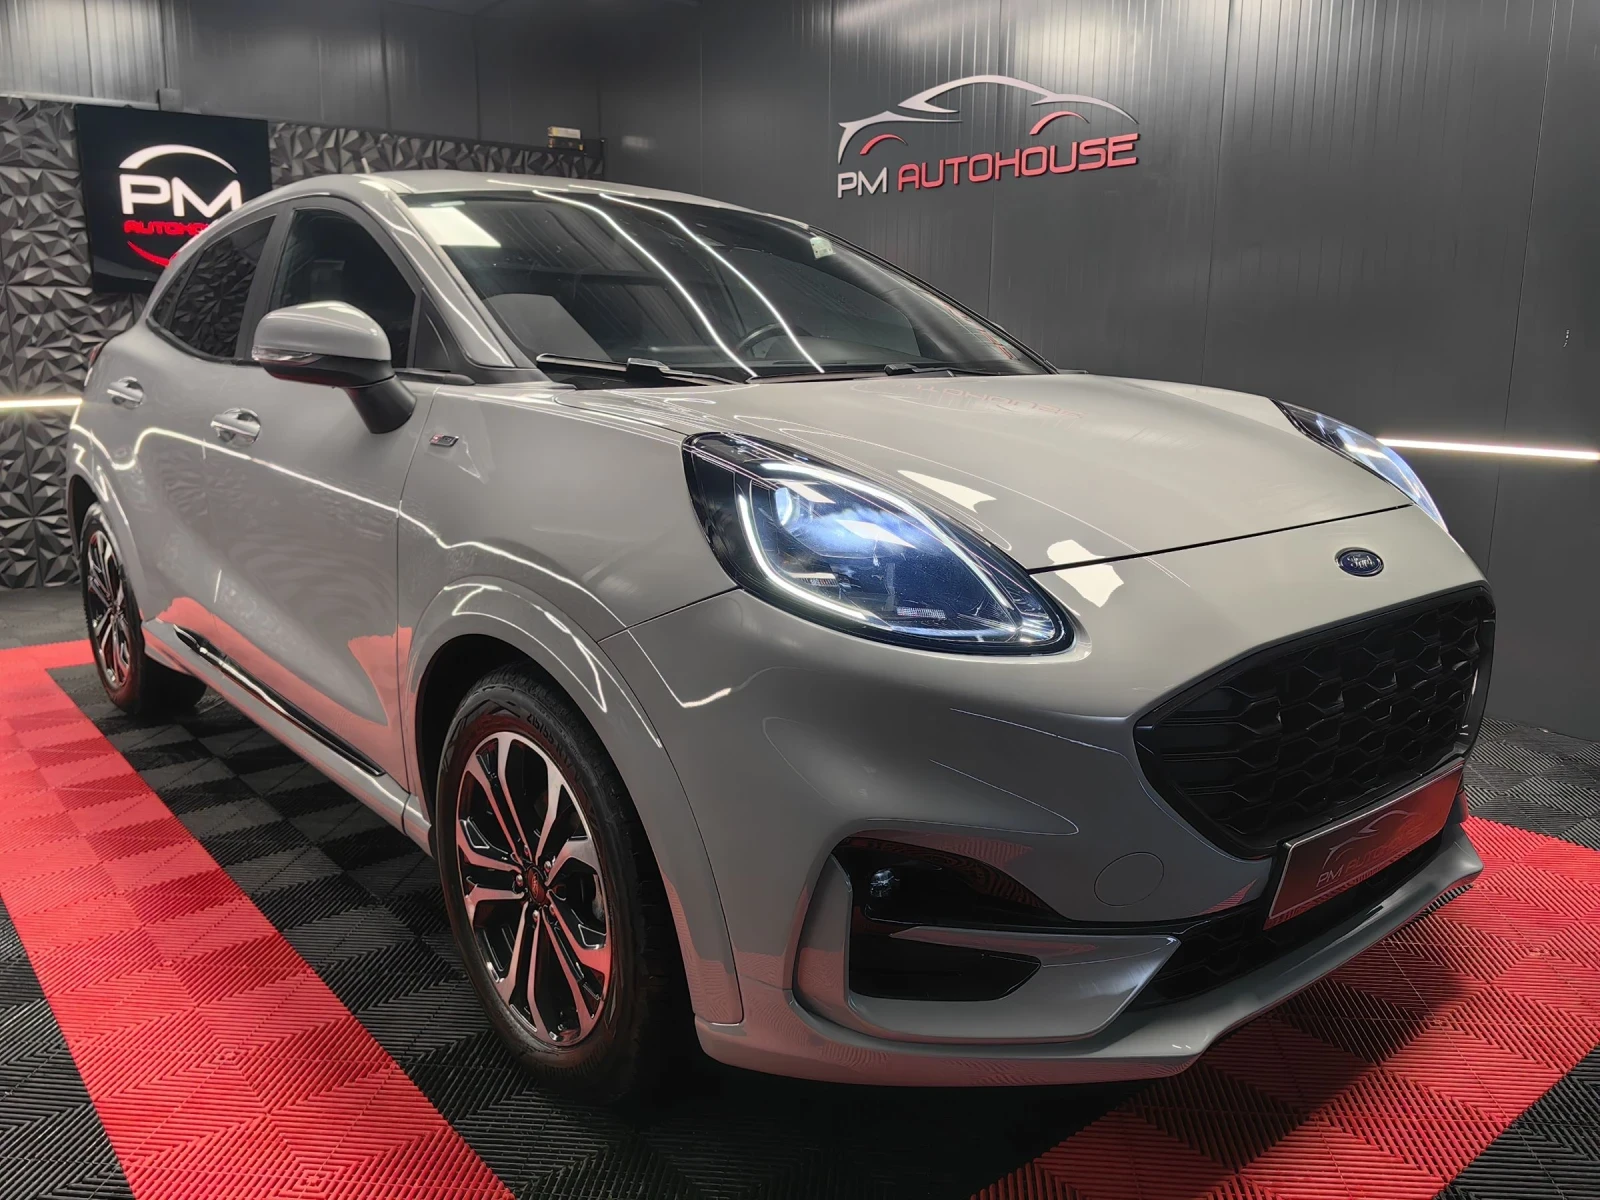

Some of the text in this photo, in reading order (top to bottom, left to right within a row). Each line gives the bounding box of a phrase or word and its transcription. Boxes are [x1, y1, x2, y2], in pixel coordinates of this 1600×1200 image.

[837, 133, 1139, 198] PM AUTOHOUSE
[120, 174, 243, 217] PM
[124, 219, 209, 236] AUTOHO
[1316, 866, 1343, 888] PM
